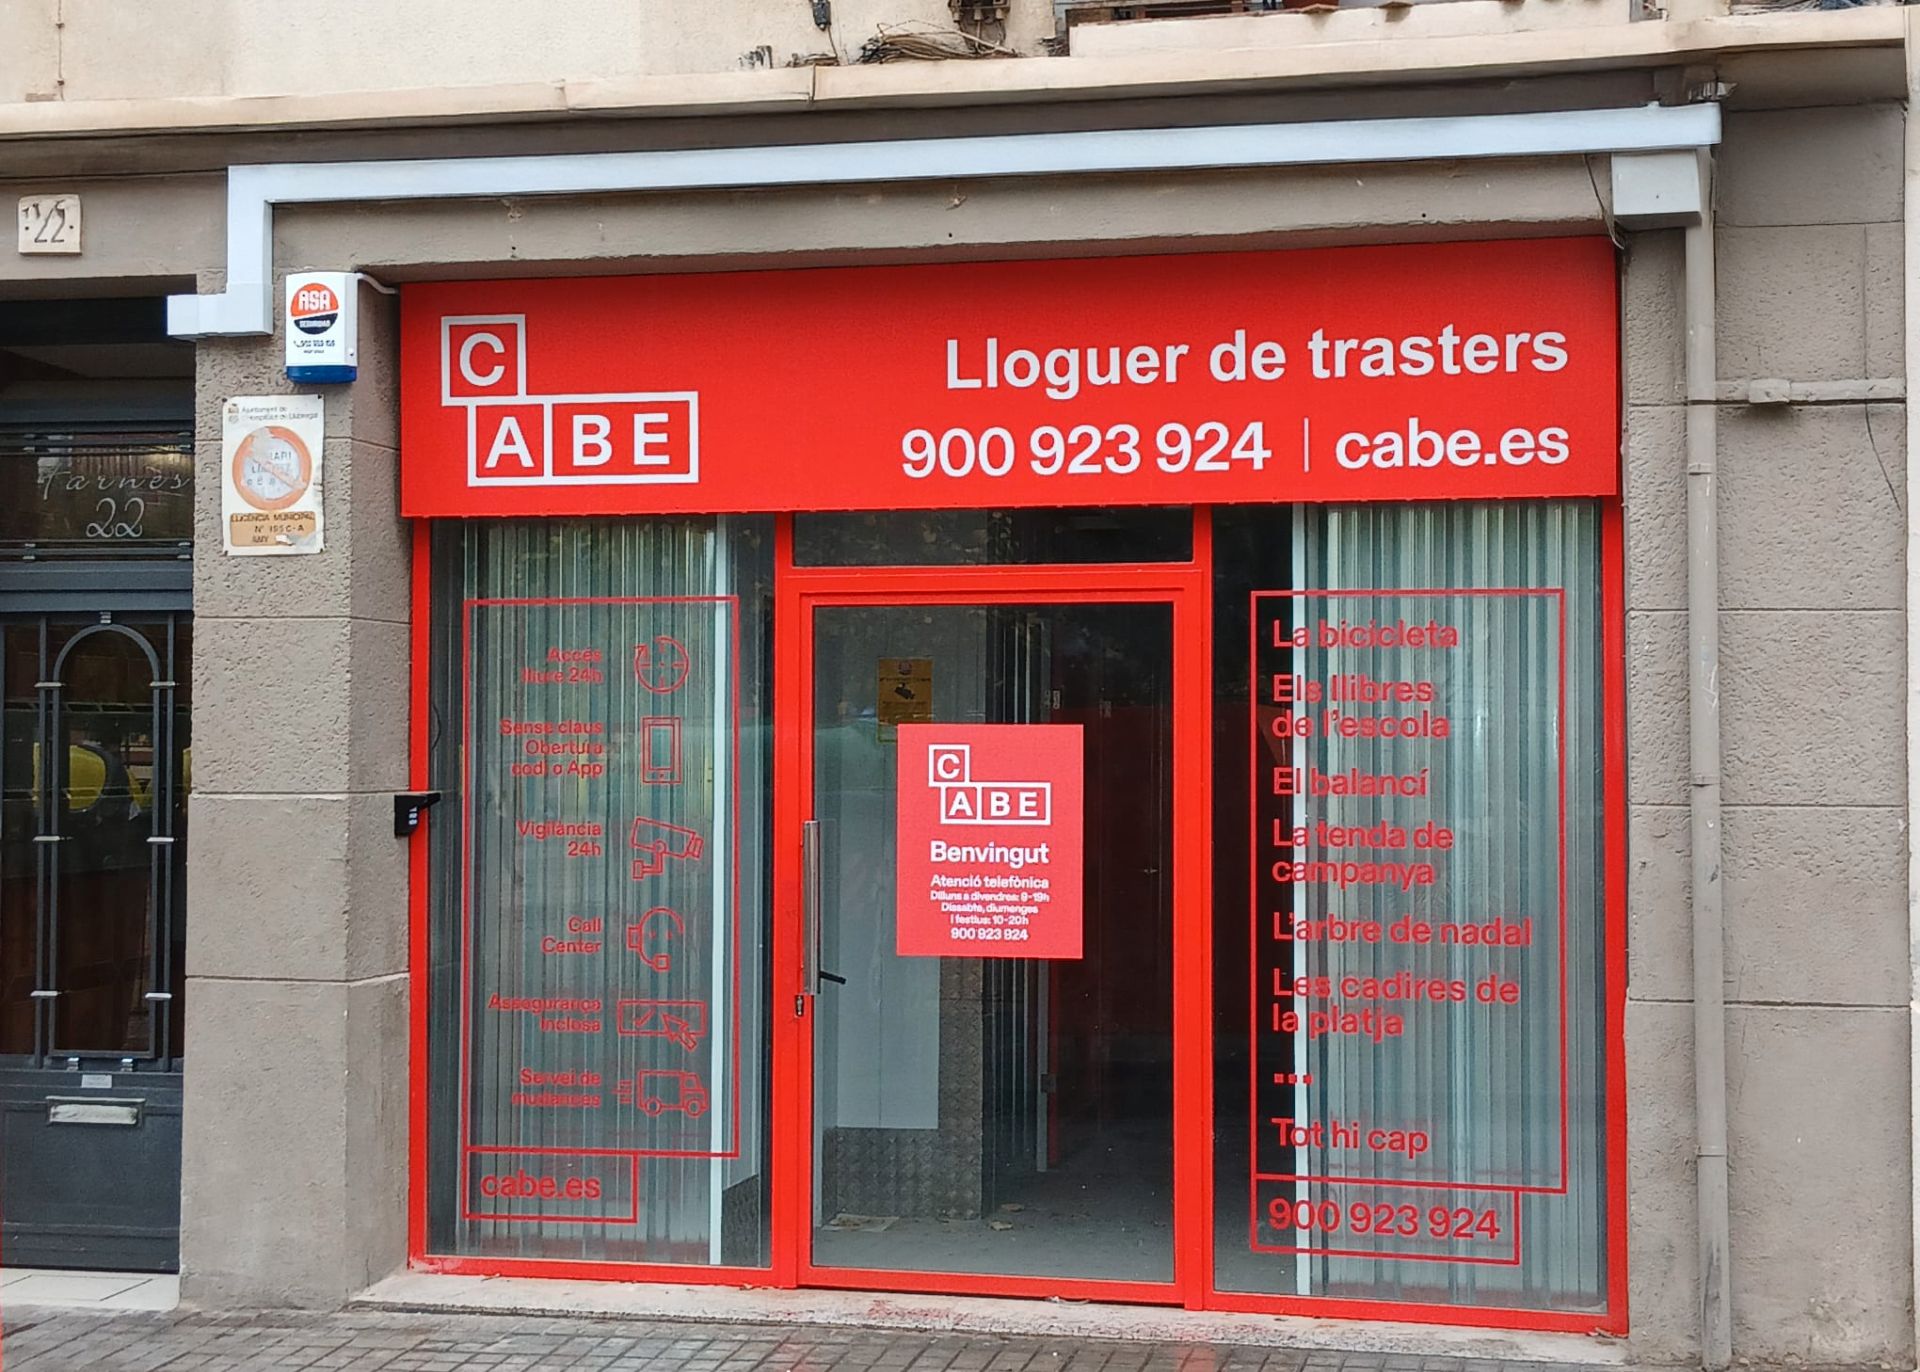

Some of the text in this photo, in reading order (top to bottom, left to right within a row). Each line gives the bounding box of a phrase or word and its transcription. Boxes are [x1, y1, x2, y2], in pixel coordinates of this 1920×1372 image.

[299, 290, 331, 311] ASA
[946, 323, 1569, 400] Lloguer de trasters
[901, 417, 1570, 478] 900 923 924 cabe.es
[86, 497, 145, 538] 22
[1273, 619, 1458, 648] La bicicleta
[547, 645, 602, 662] Accés
[522, 667, 604, 684] lliure 24h
[1273, 674, 1434, 703] Els llibres
[500, 718, 603, 735] Sense claus
[1271, 710, 1449, 739] de l'escola
[525, 738, 603, 755] Obertura
[511, 760, 603, 779] codi o App
[1273, 767, 1428, 797] El balancí
[516, 819, 602, 841] Vigilància
[1273, 818, 1454, 849] La tenda de
[567, 840, 602, 857] 24h
[930, 840, 1050, 868] Benvingut
[930, 874, 1049, 889] Atenció telefònica
[1271, 861, 1436, 892] campanya
[930, 890, 962, 901] Dilluns
[970, 891, 1020, 902] divendres:
[941, 902, 1039, 915] Dissabte, diumenges
[955, 914, 991, 925] festius:
[567, 915, 602, 933] Call
[951, 928, 1029, 940] 900 923 924
[1273, 912, 1532, 946] L'arbre de nadal
[541, 935, 602, 954] Center
[1273, 968, 1520, 1004] Les cadires de
[488, 993, 602, 1016] Assegurança
[1272, 1003, 1405, 1044] la platja
[520, 1067, 602, 1087] Servei de
[511, 1092, 602, 1107] mudances
[1271, 1117, 1428, 1160] Tot hi cap
[480, 1170, 602, 1199] cabe.es
[1268, 1197, 1501, 1240] 900 923 924
